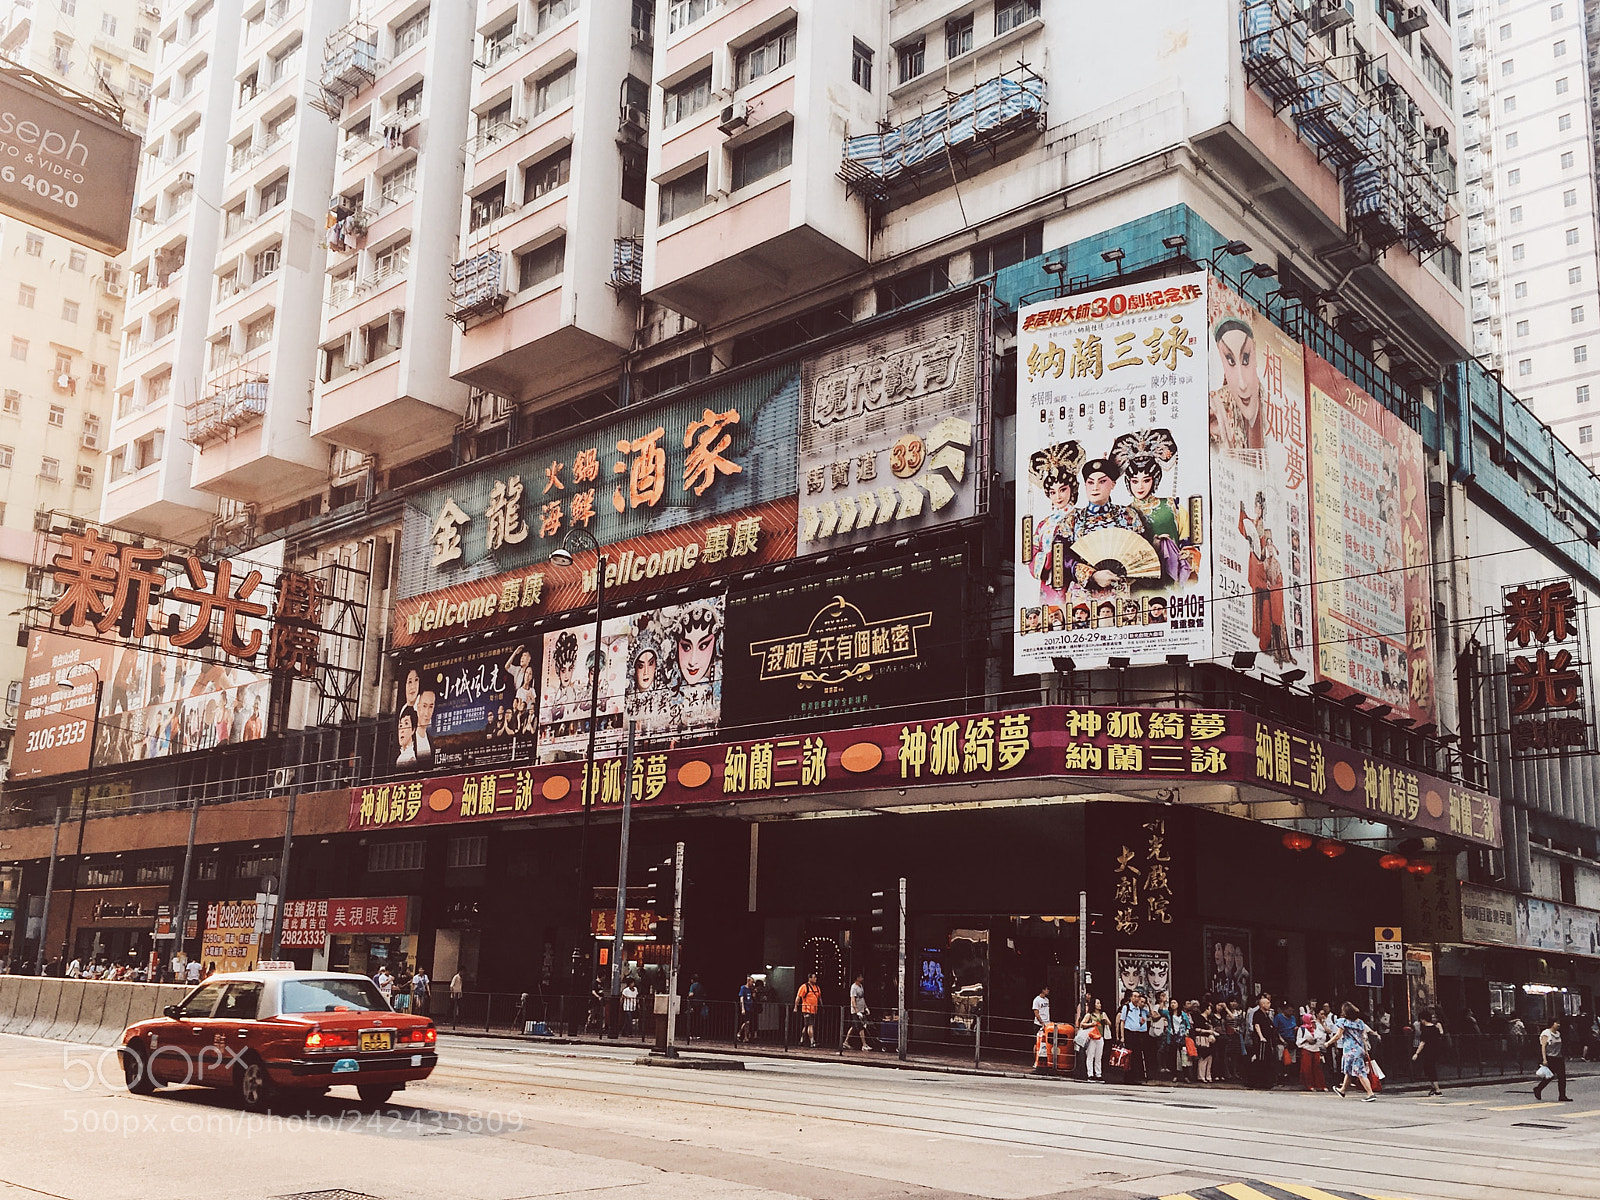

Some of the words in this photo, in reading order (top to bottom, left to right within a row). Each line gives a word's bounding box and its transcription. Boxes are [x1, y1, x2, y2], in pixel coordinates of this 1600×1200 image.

[0, 112, 89, 167] seph
[1, 165, 16, 183] 6
[20, 173, 79, 208] 4020
[24, 153, 35, 165] &
[39, 157, 84, 184] VIDEO
[1022, 284, 1204, 331] 李居明大師30劇紀念作
[1027, 315, 1194, 383] 納蘭三詠
[817, 338, 959, 418] 現代教育
[1345, 388, 1369, 417] 2017
[1263, 344, 1285, 444] 相如
[1284, 396, 1306, 491] 追夢
[543, 447, 599, 494] 火鍋
[612, 408, 744, 514] 酒家
[806, 451, 877, 496] 馬寶道
[891, 440, 923, 472] 33
[430, 474, 530, 568] 金龍
[539, 488, 596, 538] 海鮮
[581, 540, 699, 593] Wellcome
[701, 515, 763, 565] 惠康
[50, 527, 268, 658] 新光
[407, 591, 498, 635] Wellcome
[498, 571, 546, 613] 惠康
[1169, 594, 1205, 618] 8月10日
[767, 624, 910, 672] 我和青天有個秘密
[1505, 581, 1578, 714] 新光
[25, 727, 57, 753] 3106
[55, 720, 87, 747] 3333
[1066, 710, 1226, 741] 神狐綺夢
[359, 783, 424, 826] 神狐綺夢
[460, 770, 535, 817] 納蘭三詠
[723, 736, 828, 793] 納蘭三詠
[898, 713, 1031, 779] 神狐綺夢
[1066, 742, 1228, 774] 納蘭三詠
[1255, 722, 1327, 795] 納蘭三詠
[1363, 758, 1420, 821] 神狐綺夢
[1449, 788, 1495, 842] 納蘭三詠
[206, 904, 219, 928] 租
[333, 904, 399, 927] 美視眼鏡
[1114, 845, 1142, 936] 大劇場
[281, 930, 326, 945] 29823333
